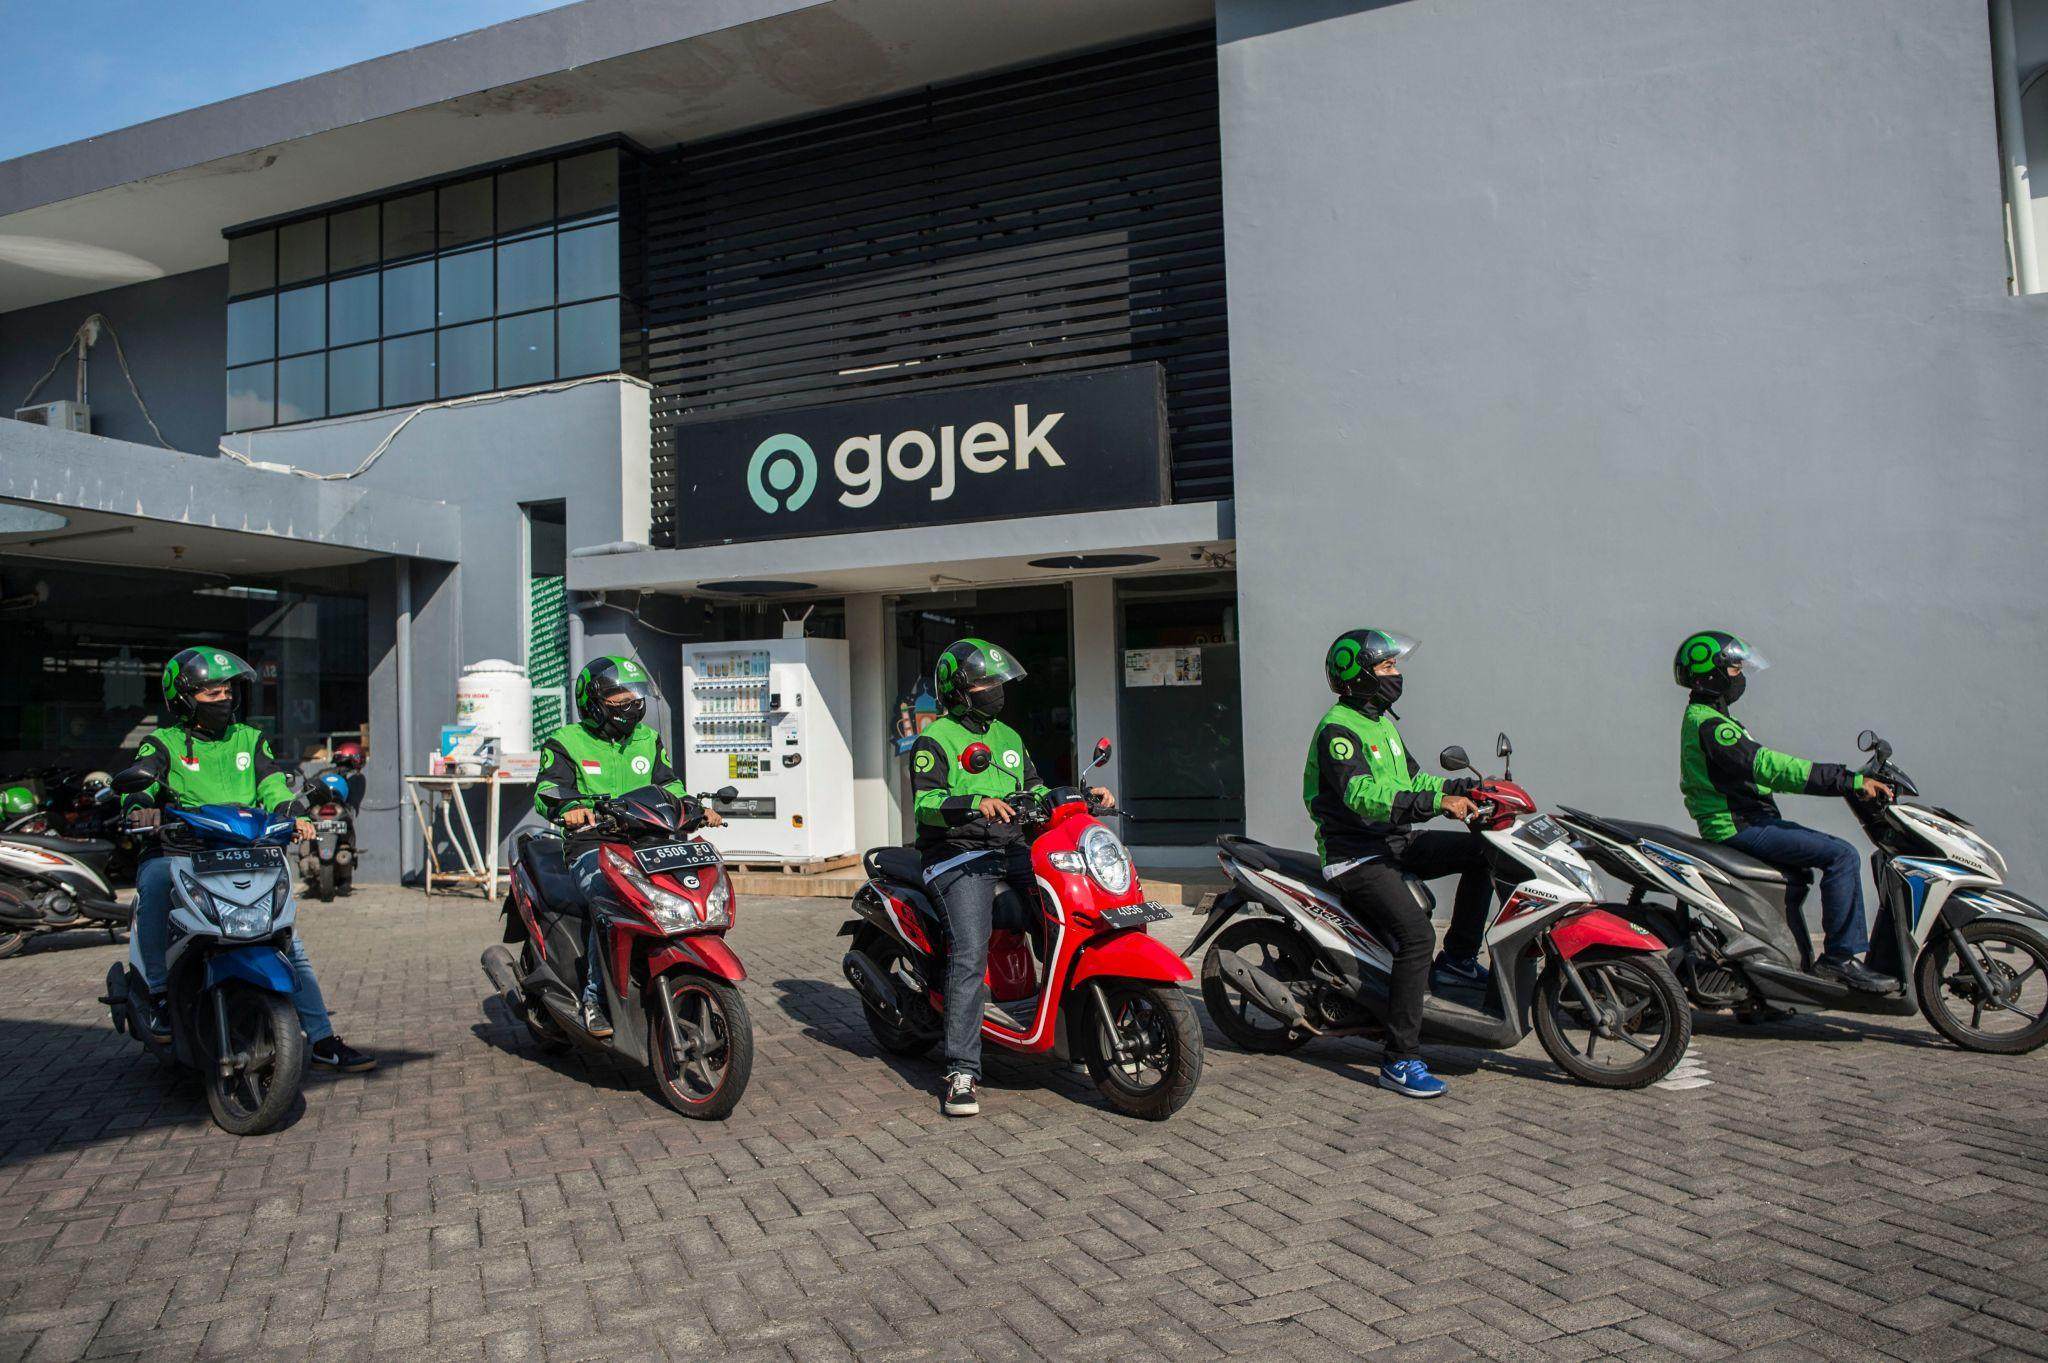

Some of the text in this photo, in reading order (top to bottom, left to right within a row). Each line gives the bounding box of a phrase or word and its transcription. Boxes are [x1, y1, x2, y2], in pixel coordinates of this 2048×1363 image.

[834, 404, 1066, 508] gojek
[215, 850, 251, 860] 5456
[640, 852, 652, 862] L
[656, 846, 688, 859] 6506
[1952, 853, 1982, 870] HONDA
[1524, 886, 1560, 900] HONDA
[1101, 910, 1112, 920] L
[1116, 904, 1143, 917] 4056
